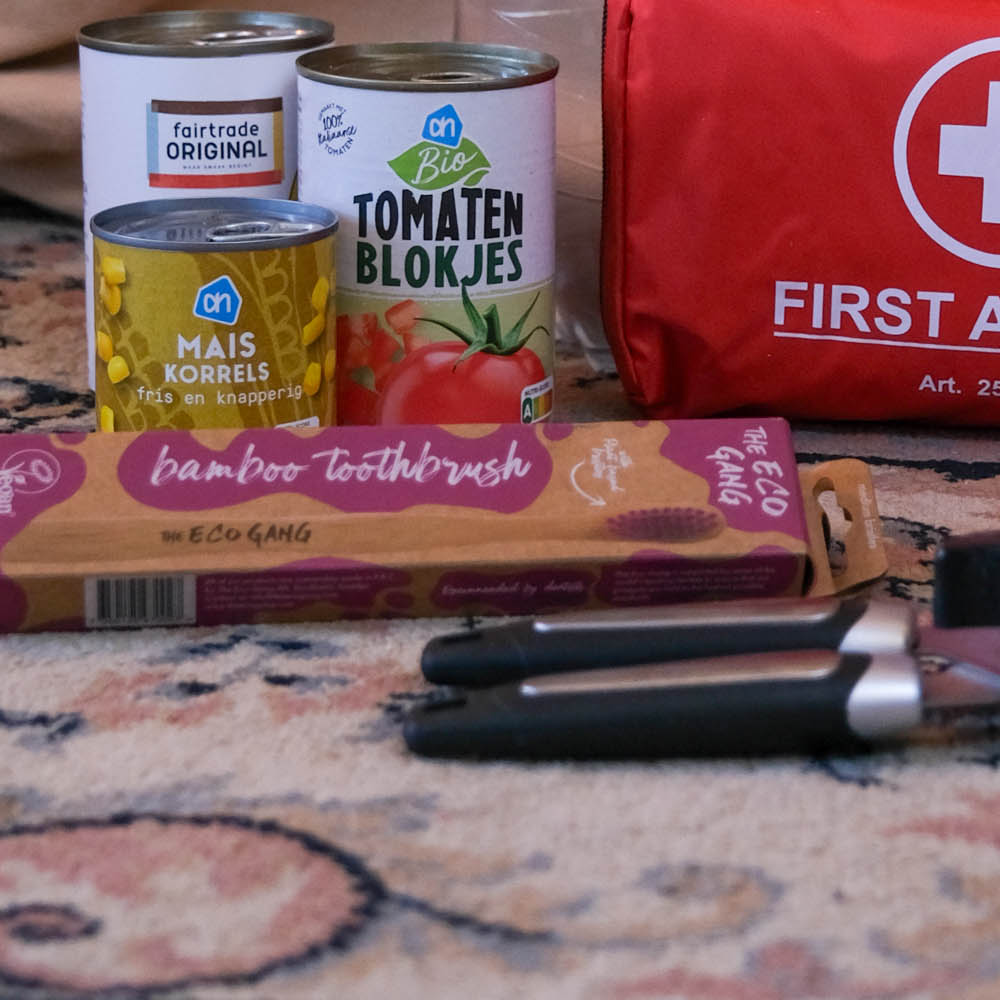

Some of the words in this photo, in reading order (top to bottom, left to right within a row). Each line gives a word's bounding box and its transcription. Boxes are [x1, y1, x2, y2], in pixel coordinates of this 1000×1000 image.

[174, 121, 259, 139] fairtrade
[166, 139, 268, 160] ORIGINAL
[410, 146, 479, 185] Bio
[353, 187, 523, 241] TOMATEN
[356, 239, 523, 289] BLOKJES
[774, 280, 955, 339] FIRST
[177, 331, 256, 359] MAIS
[164, 361, 270, 384] KORRELS
[919, 373, 962, 395] Art.
[137, 386, 173, 404] fris
[184, 391, 205, 405] en
[216, 385, 303, 406] knapperig
[742, 425, 769, 456] THE
[150, 443, 310, 486] bamboo
[312, 439, 531, 488] toothbrush
[705, 445, 753, 506] GANG
[752, 460, 790, 516] ECO
[161, 528, 186, 544] THE
[189, 522, 242, 544] ECO
[247, 521, 313, 548] GANG
